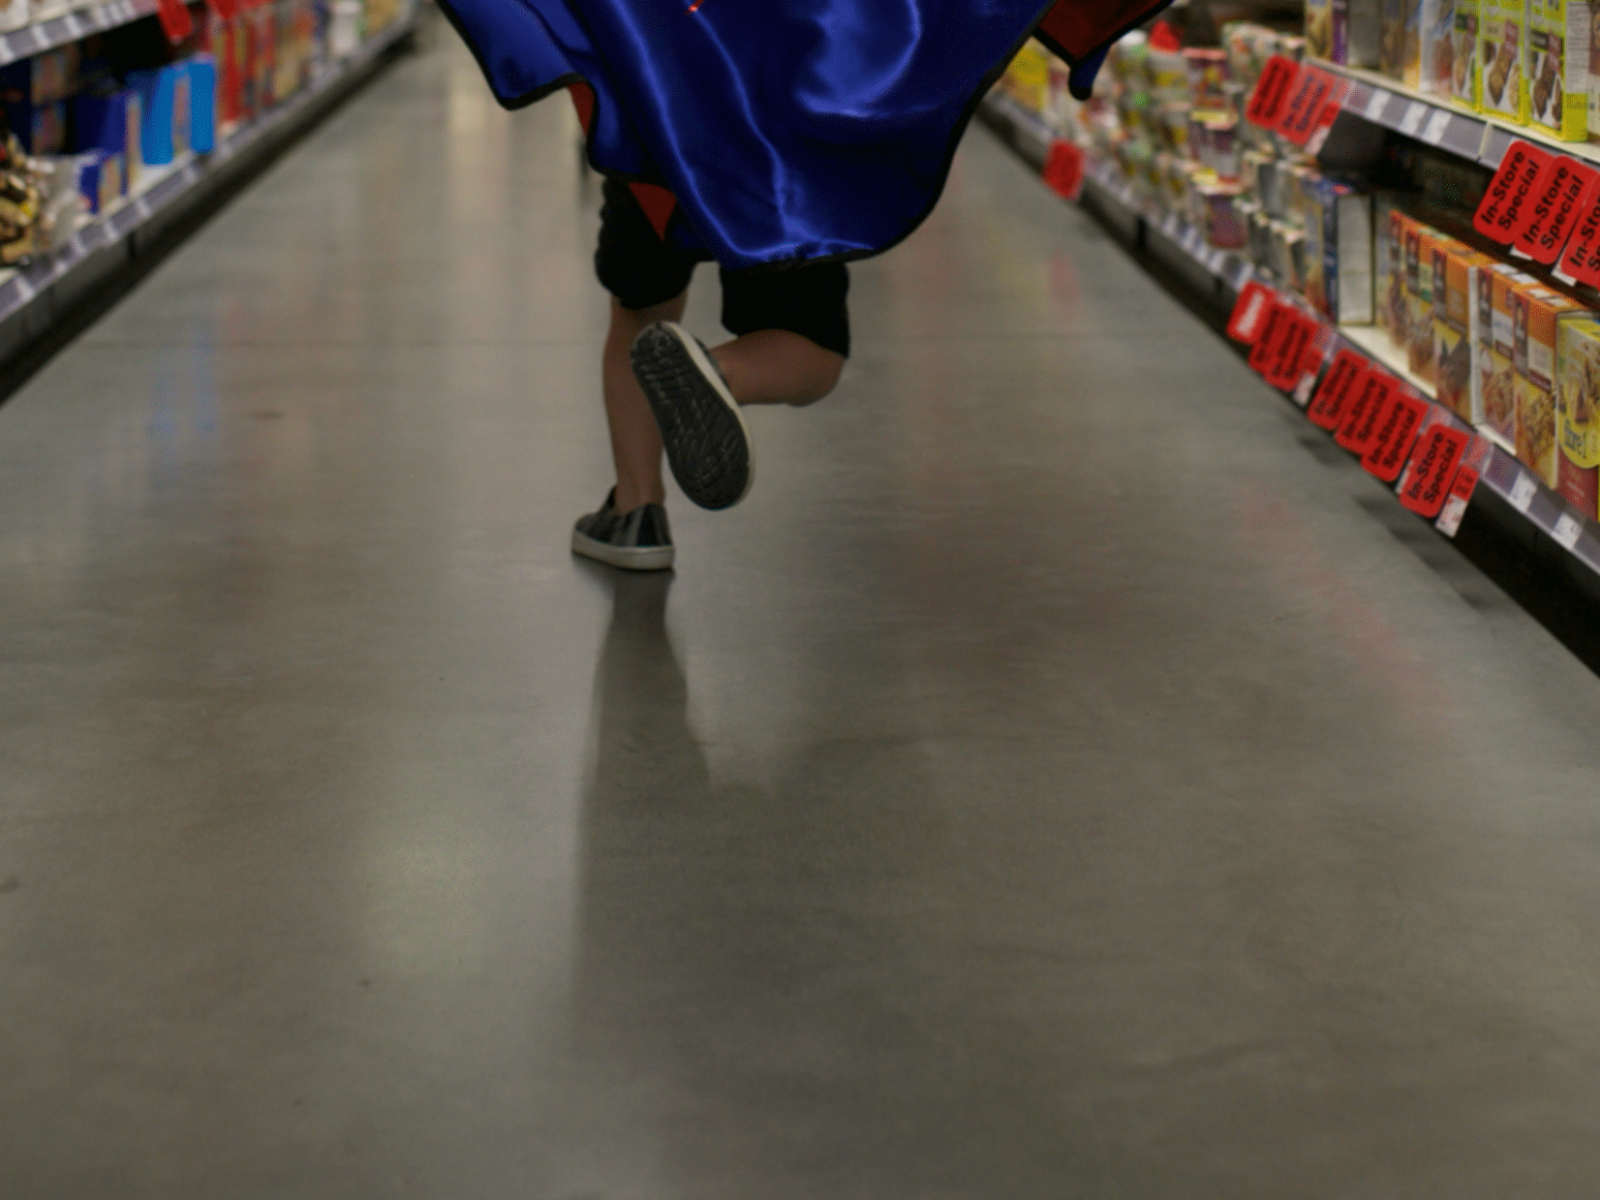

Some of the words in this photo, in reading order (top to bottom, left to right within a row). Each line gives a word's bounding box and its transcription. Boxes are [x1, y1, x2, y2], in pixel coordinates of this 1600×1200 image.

[1480, 151, 1525, 225] In-Store
[1498, 159, 1540, 230] Special
[1522, 167, 1569, 245] In-Store
[1540, 174, 1584, 250] Special
